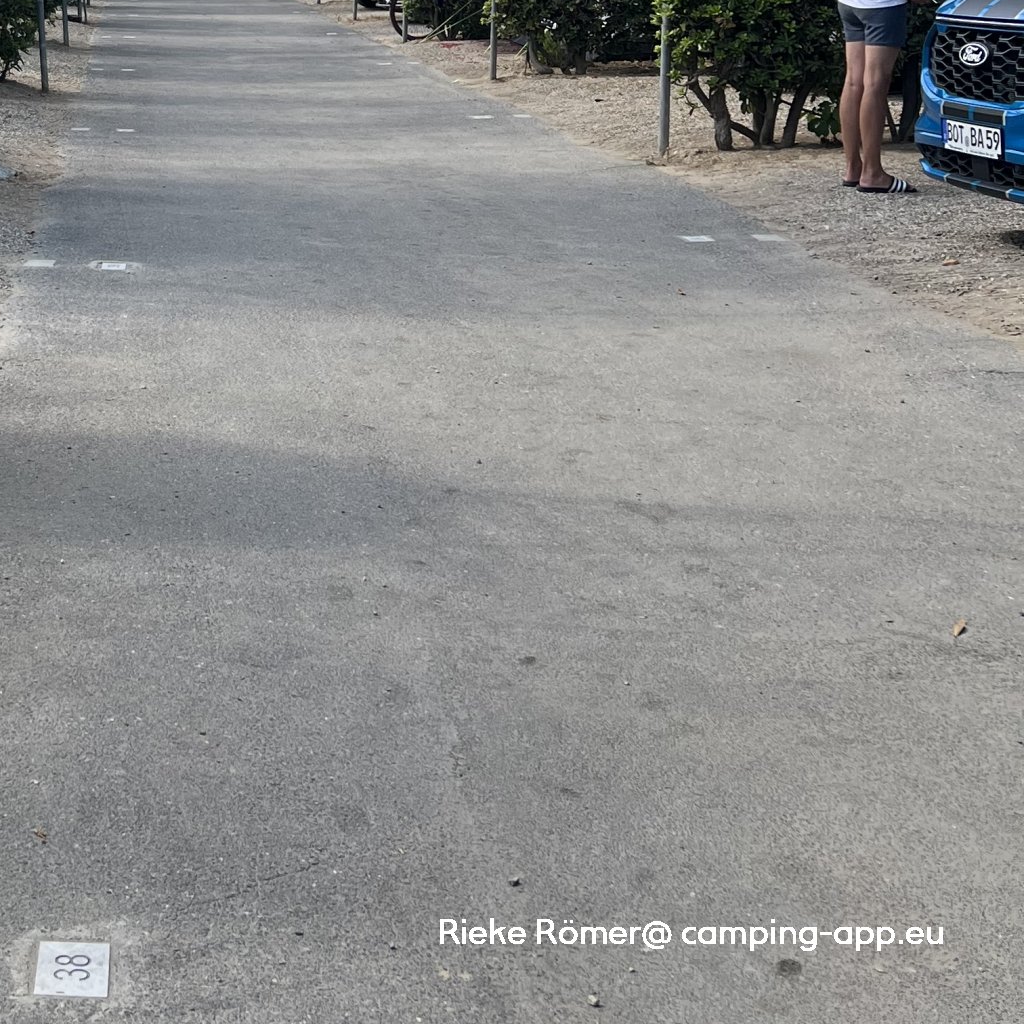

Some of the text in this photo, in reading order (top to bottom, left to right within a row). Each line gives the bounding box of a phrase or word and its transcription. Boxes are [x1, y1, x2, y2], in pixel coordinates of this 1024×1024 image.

[962, 45, 983, 63] Ford
[947, 122, 964, 144] BOT
[53, 954, 92, 982] 38
